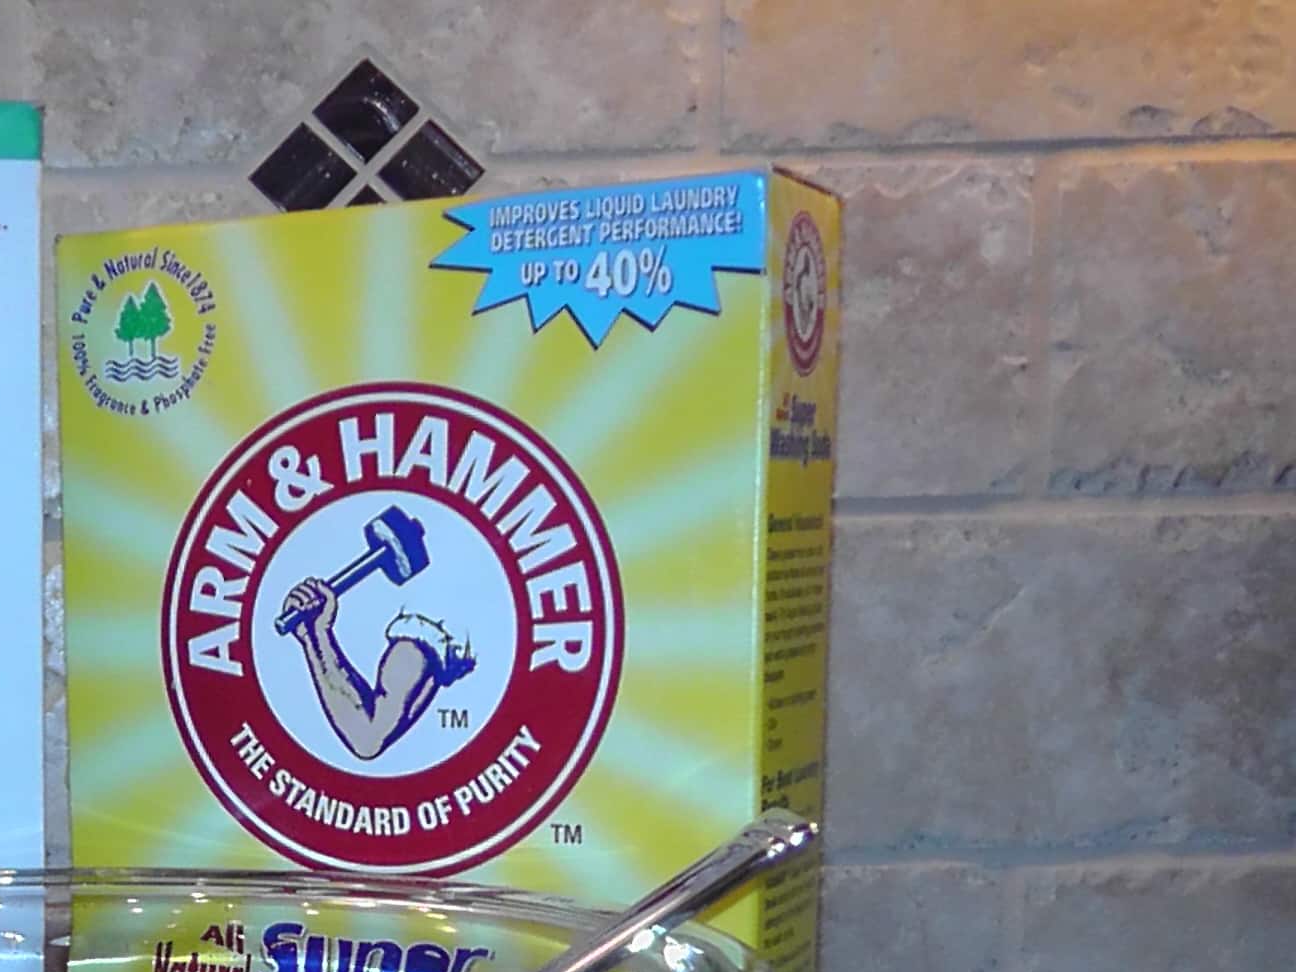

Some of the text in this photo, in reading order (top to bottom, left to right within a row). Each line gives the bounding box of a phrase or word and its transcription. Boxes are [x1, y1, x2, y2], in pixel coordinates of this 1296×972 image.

[489, 184, 739, 229] IMPROVES LIQUID LAUNDRY
[491, 210, 743, 253] DETERGENT PERFORMANCE!
[71, 289, 97, 325] Pure
[91, 273, 107, 291] &
[103, 246, 159, 281] Natural
[519, 244, 674, 298] UP TO 40%
[85, 374, 137, 416] Fragrance
[140, 398, 150, 416] &
[153, 359, 208, 414] Phosphate
[188, 410, 595, 677] ARM & HAMMER
[437, 708, 470, 729] TM
[229, 721, 543, 837] THE STANDARD OF PURITY
[550, 823, 583, 844] TM
[200, 923, 245, 954] All
